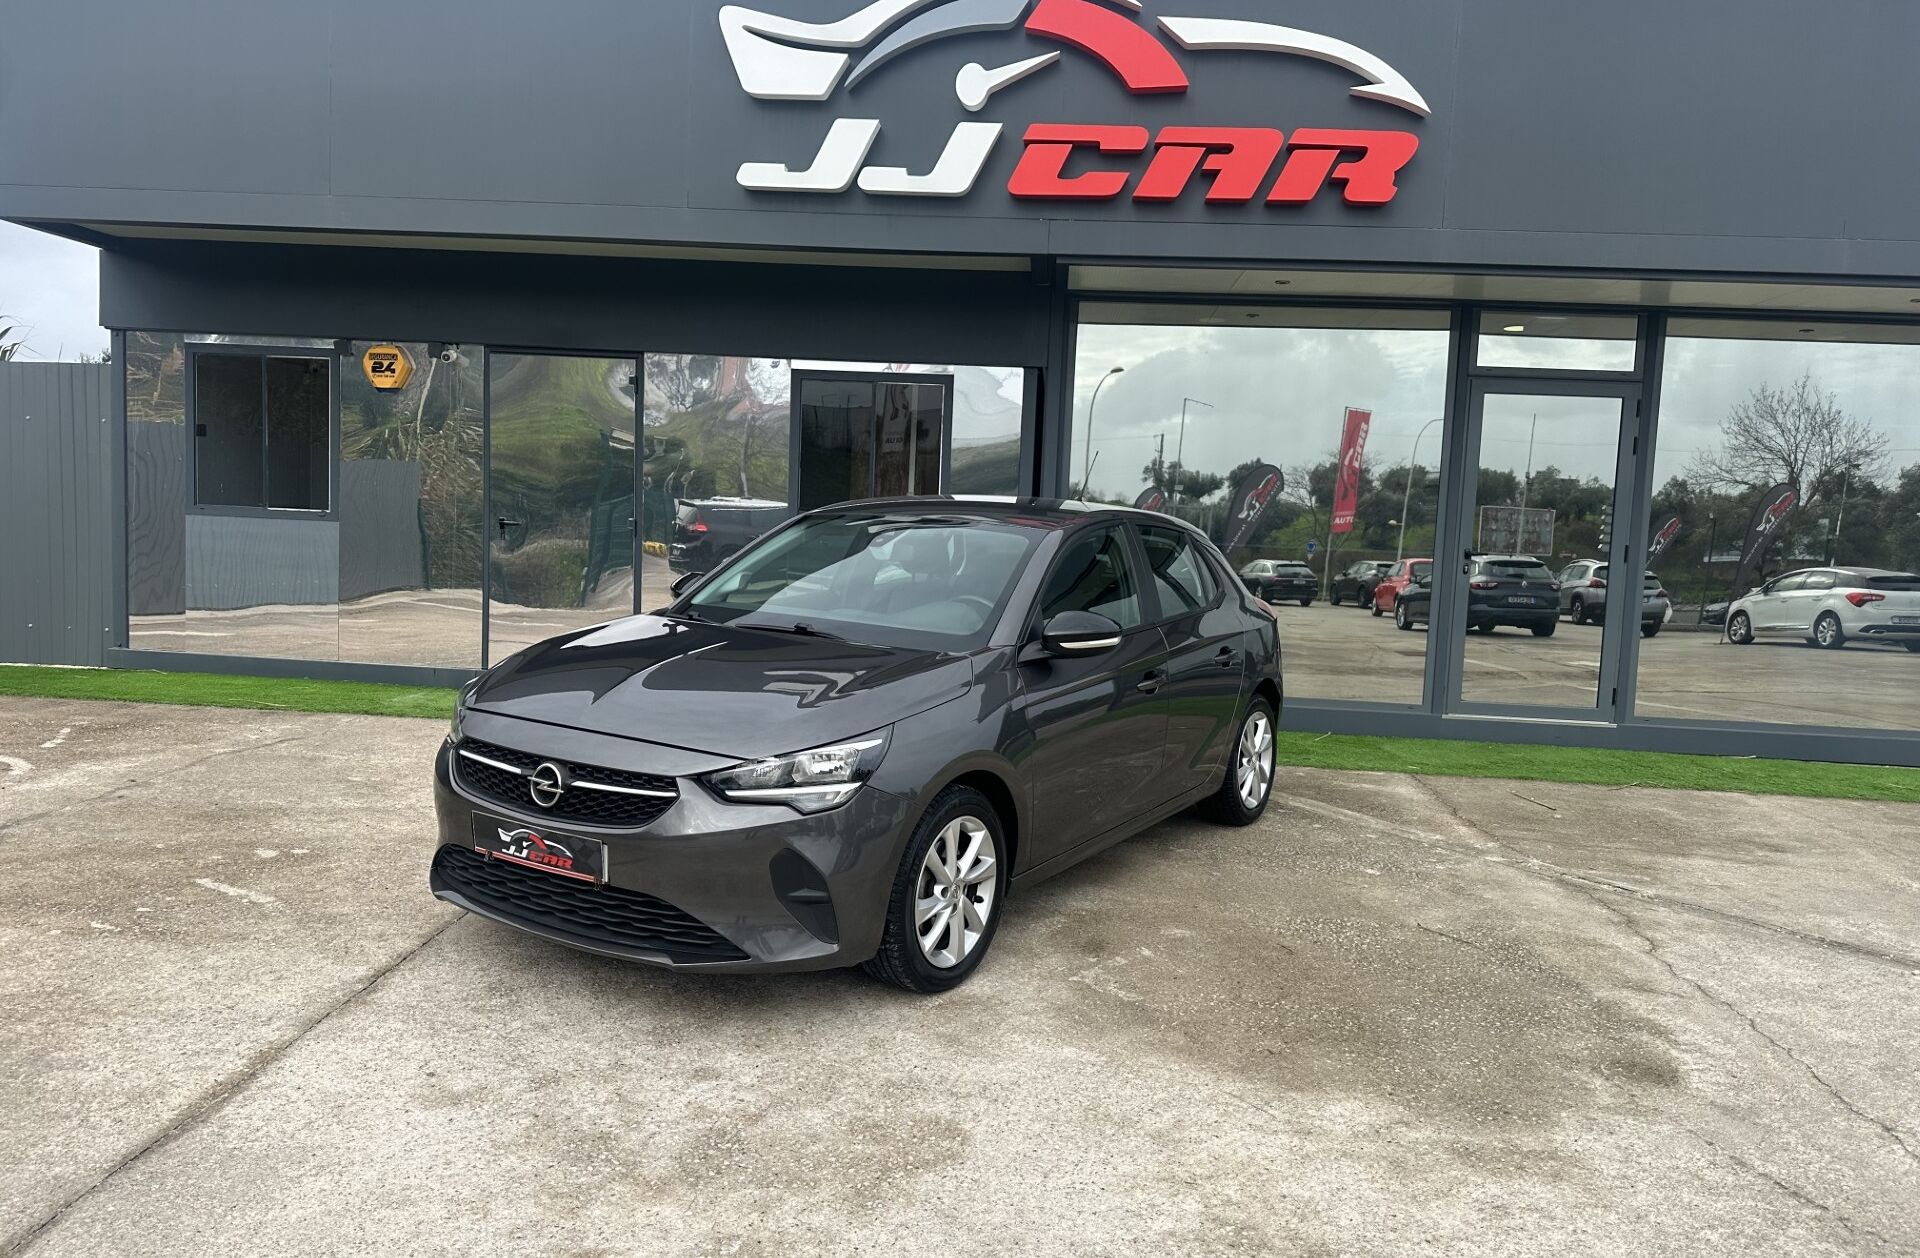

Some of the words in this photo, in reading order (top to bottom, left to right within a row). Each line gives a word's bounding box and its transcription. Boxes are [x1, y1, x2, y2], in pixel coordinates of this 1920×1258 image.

[736, 117, 1005, 197] JJ
[1007, 123, 1421, 206] CAR
[371, 361, 396, 374] 24
[501, 845, 529, 858] JJ
[529, 850, 573, 869] CAR
